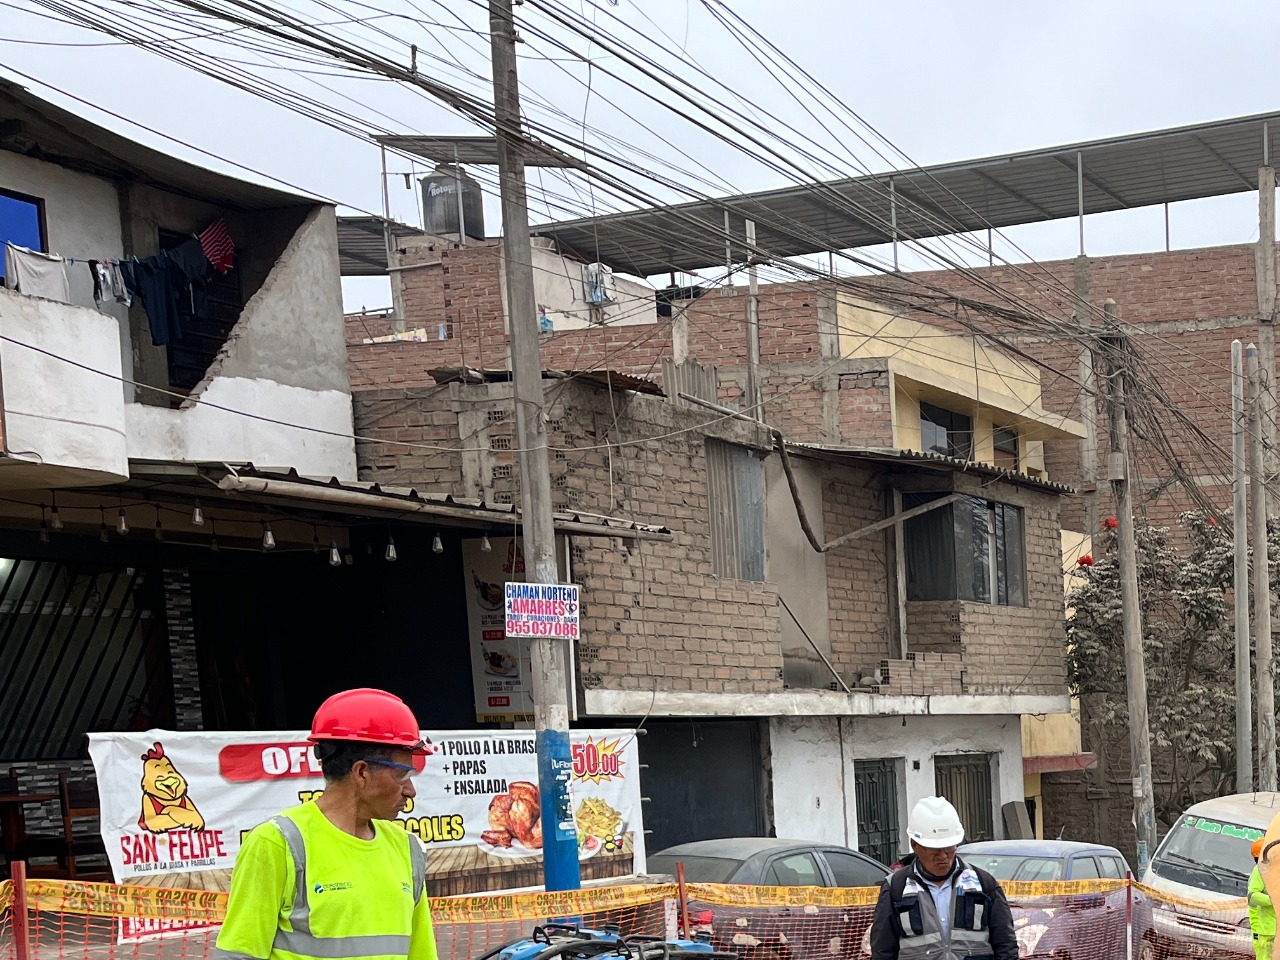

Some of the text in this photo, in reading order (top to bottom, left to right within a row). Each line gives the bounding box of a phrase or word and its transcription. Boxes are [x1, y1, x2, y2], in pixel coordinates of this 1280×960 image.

[506, 584, 540, 600] CHAMAN
[512, 599, 565, 616] AMARRES
[507, 613, 523, 621] TAROT
[440, 740, 537, 755] 1 POLLO A LA BRAS
[453, 760, 486, 775] PAPAS
[454, 778, 507, 795] ENSALADA
[121, 829, 227, 865] SAN FELIPE
[134, 864, 152, 872] POLLOS
